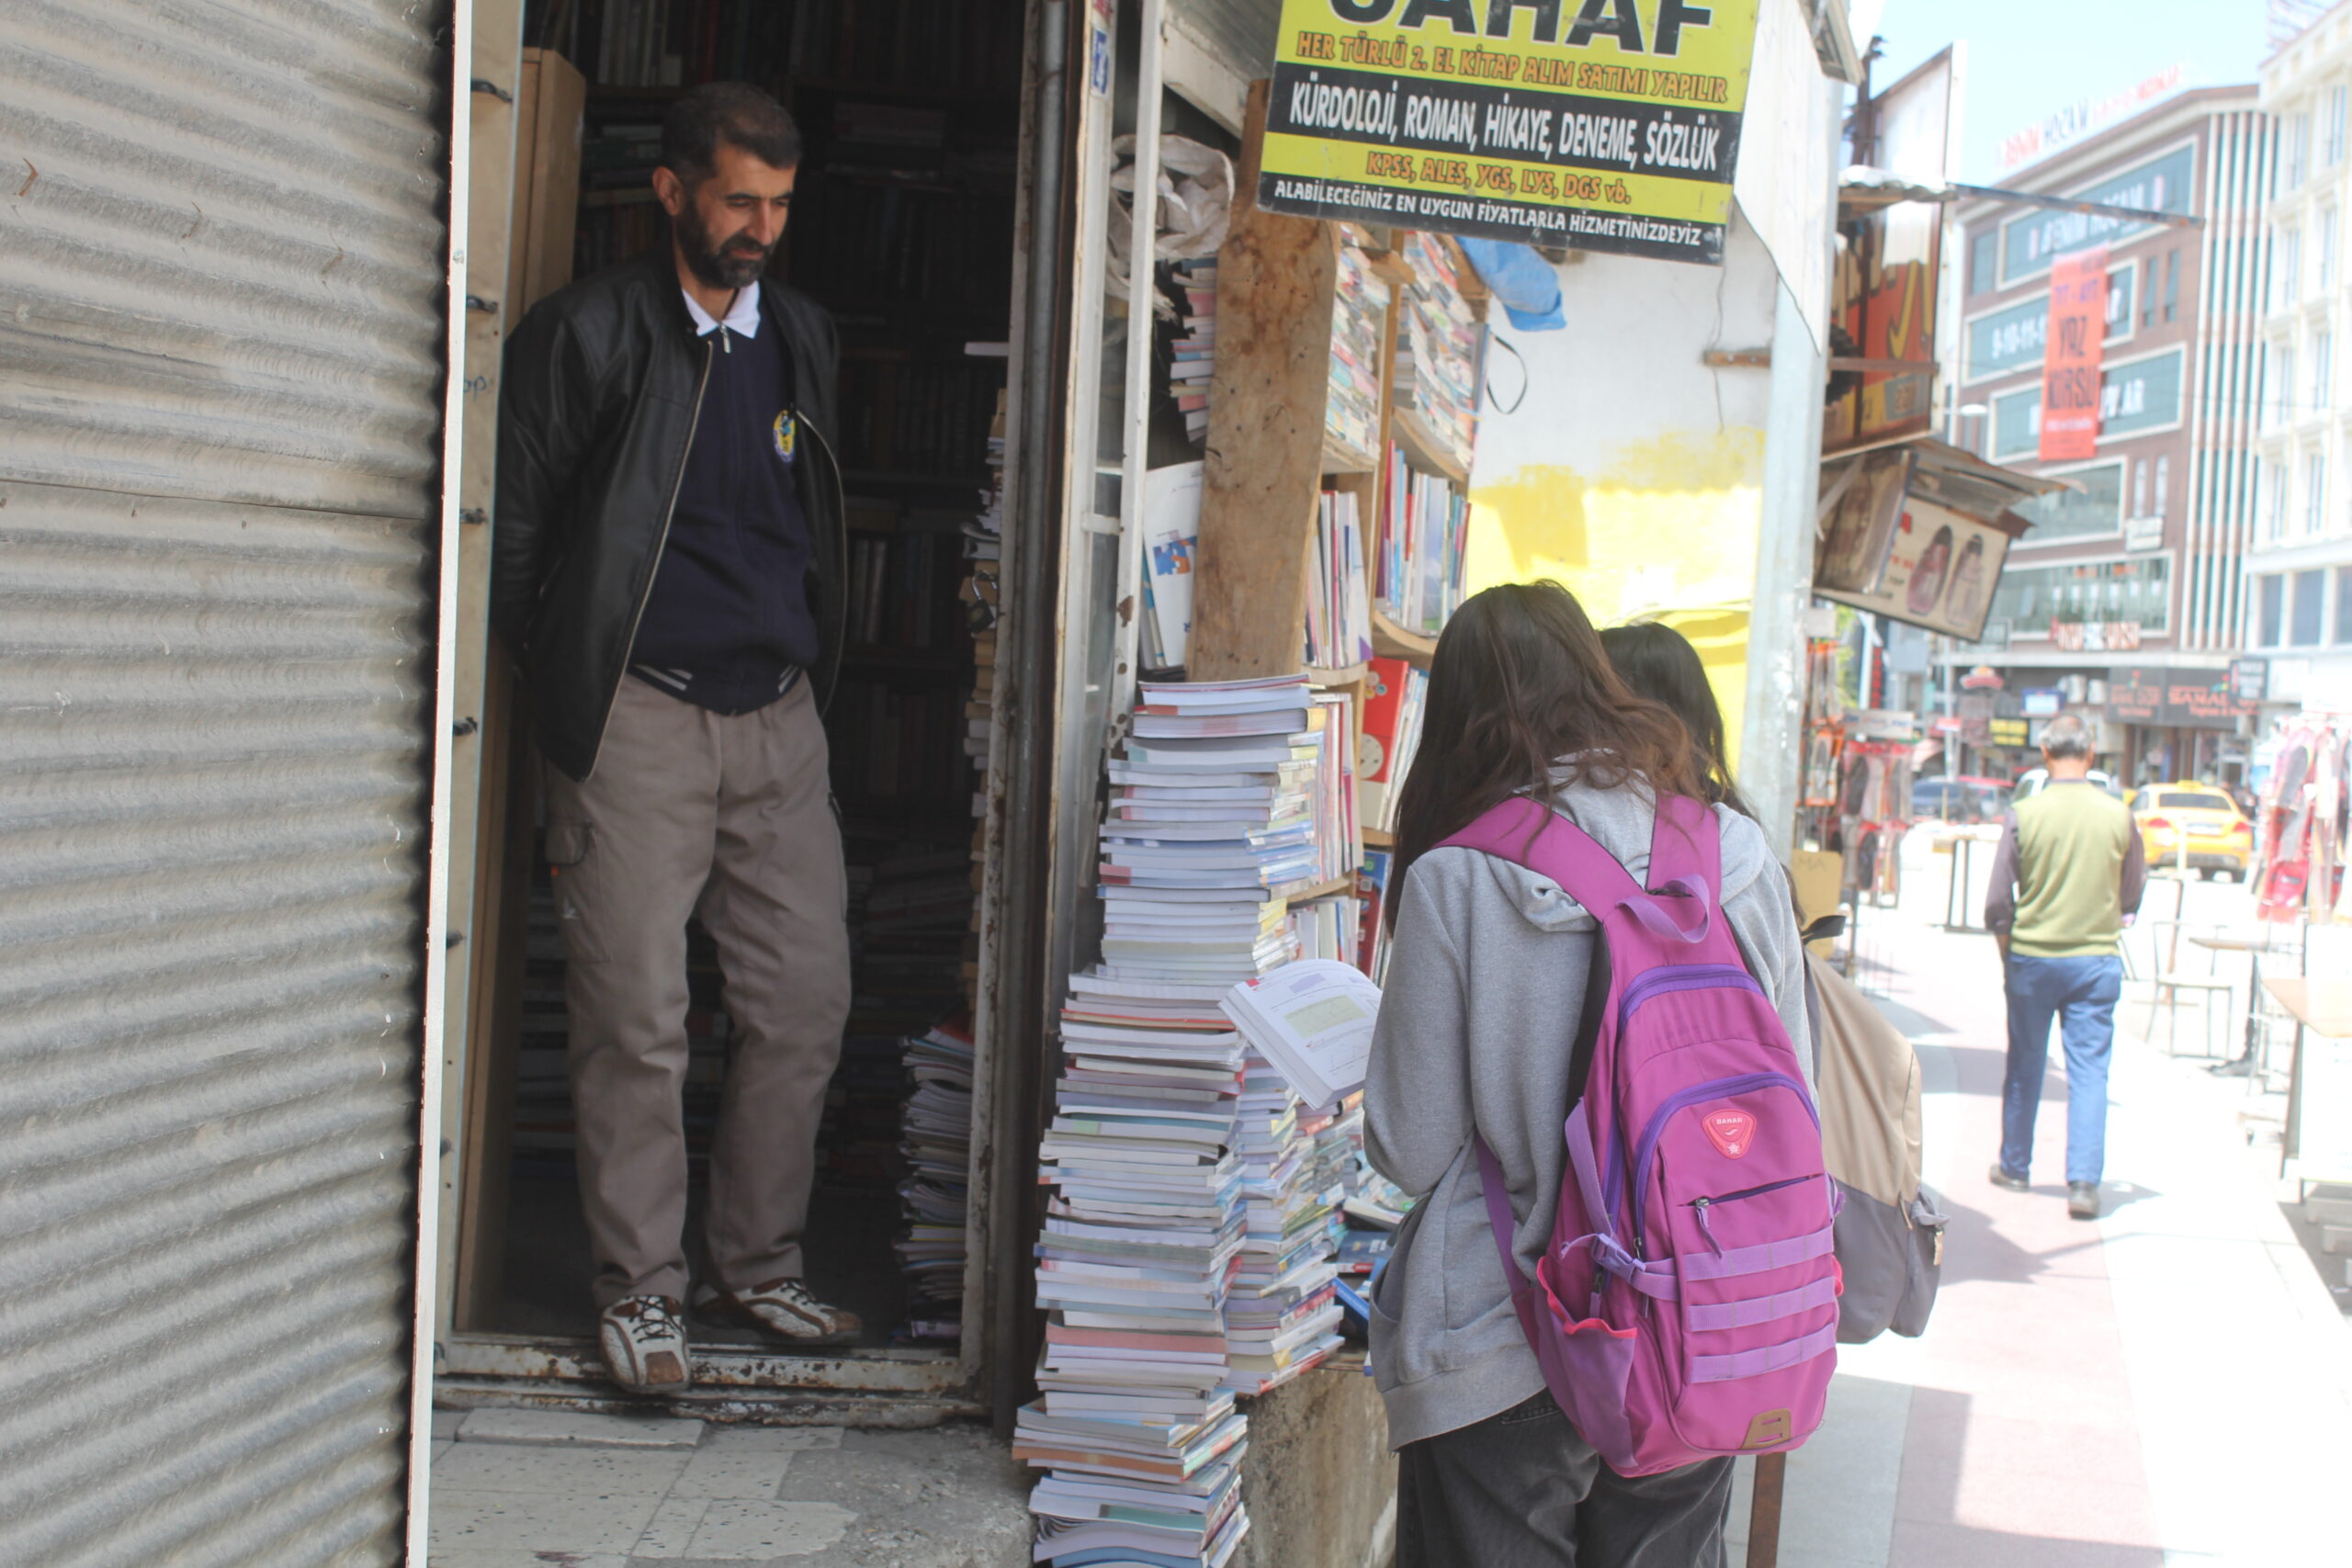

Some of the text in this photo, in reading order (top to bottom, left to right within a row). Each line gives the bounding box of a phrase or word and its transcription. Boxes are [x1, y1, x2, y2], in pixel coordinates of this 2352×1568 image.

[1329, 0, 1712, 57] HAF
[1296, 30, 1727, 104] HER TÜRLÜ 2. EL KİTAP ALIM SATIMI YAPILIR
[1290, 71, 1719, 172] KÜRDOLOJİ, ROMAN, HİKAYE, DENEME, SÖZLÜK
[1366, 151, 1632, 205] KPSS, ALES, YGS, LYS, DGS vb.
[1274, 179, 1702, 246] ALABİLECEĞİNİZ EN UYGUN FİYATLARLA HİZMETİNİZDEYİZ
